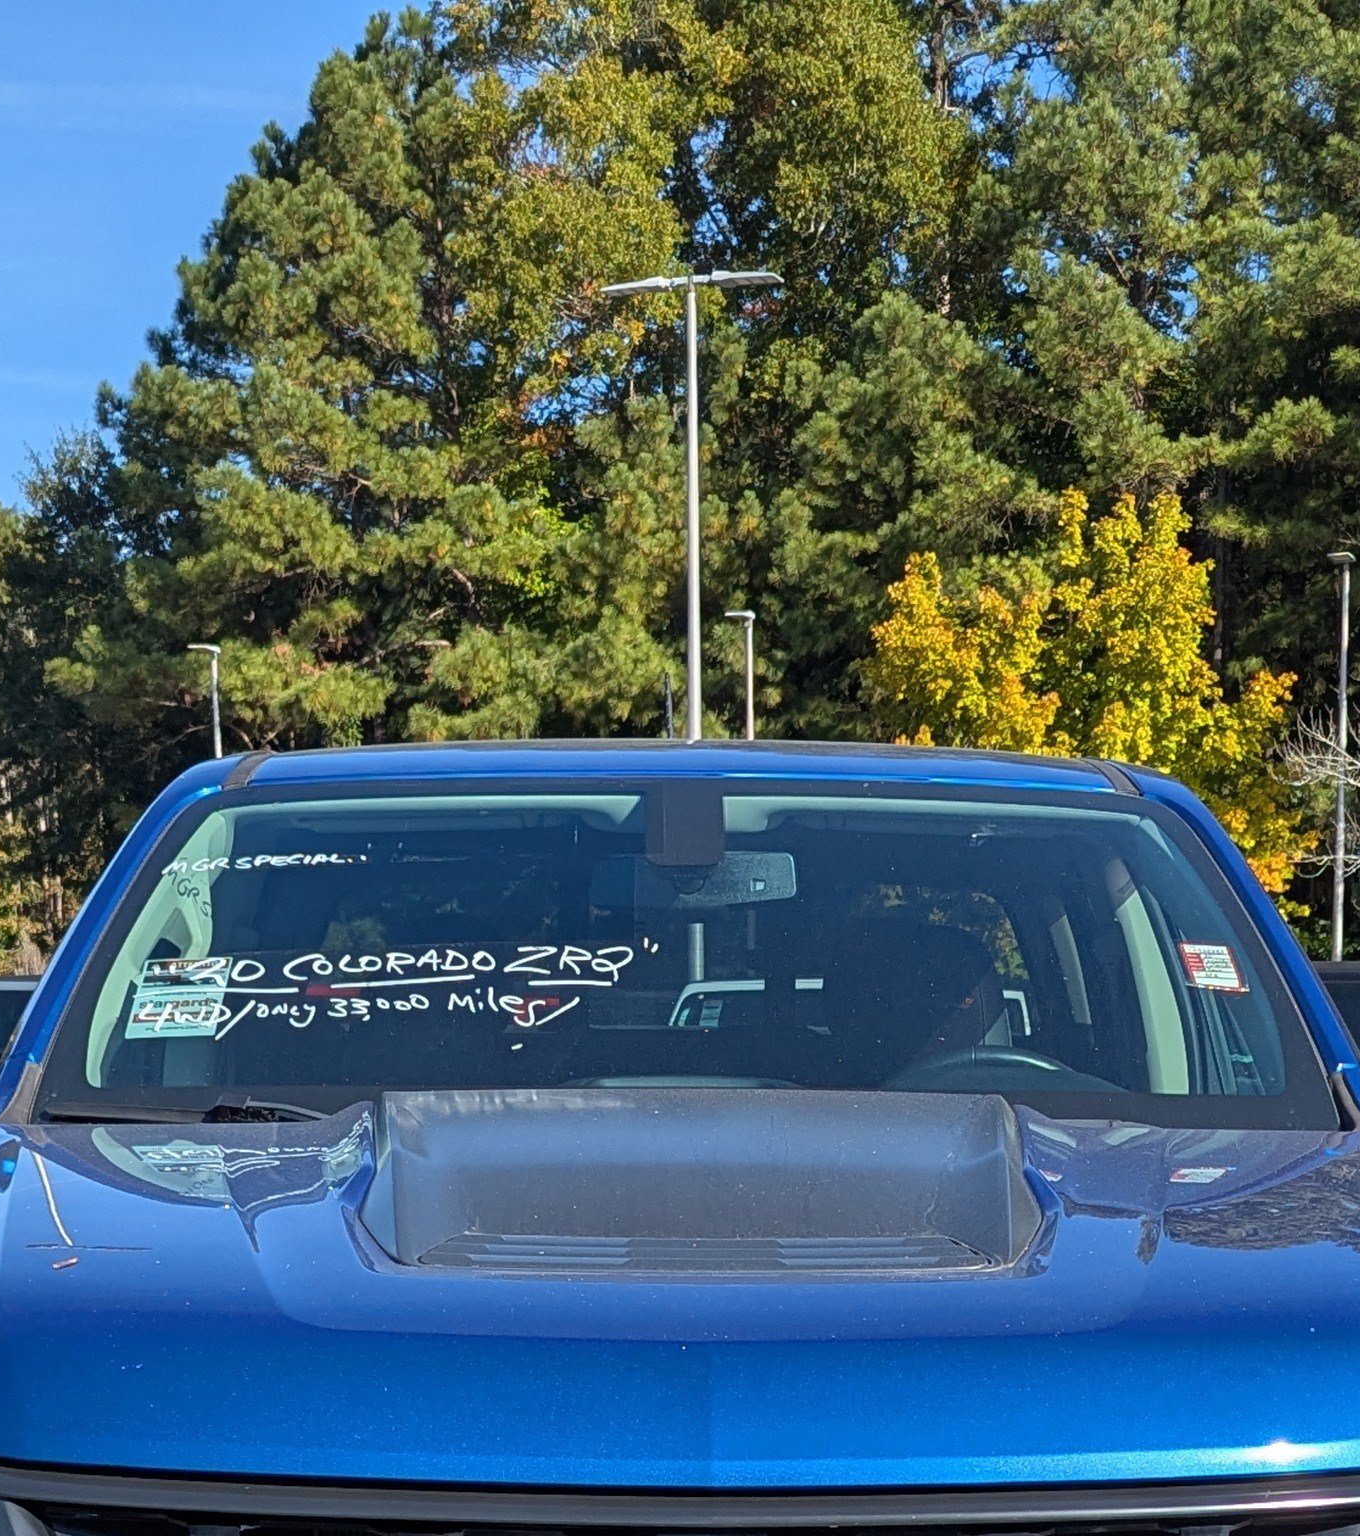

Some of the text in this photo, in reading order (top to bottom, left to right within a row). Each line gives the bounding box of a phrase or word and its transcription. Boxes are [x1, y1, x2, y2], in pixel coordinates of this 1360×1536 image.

[162, 856, 230, 875] MGR
[283, 949, 496, 981] COLORADO
[327, 993, 430, 1022] 33,000
